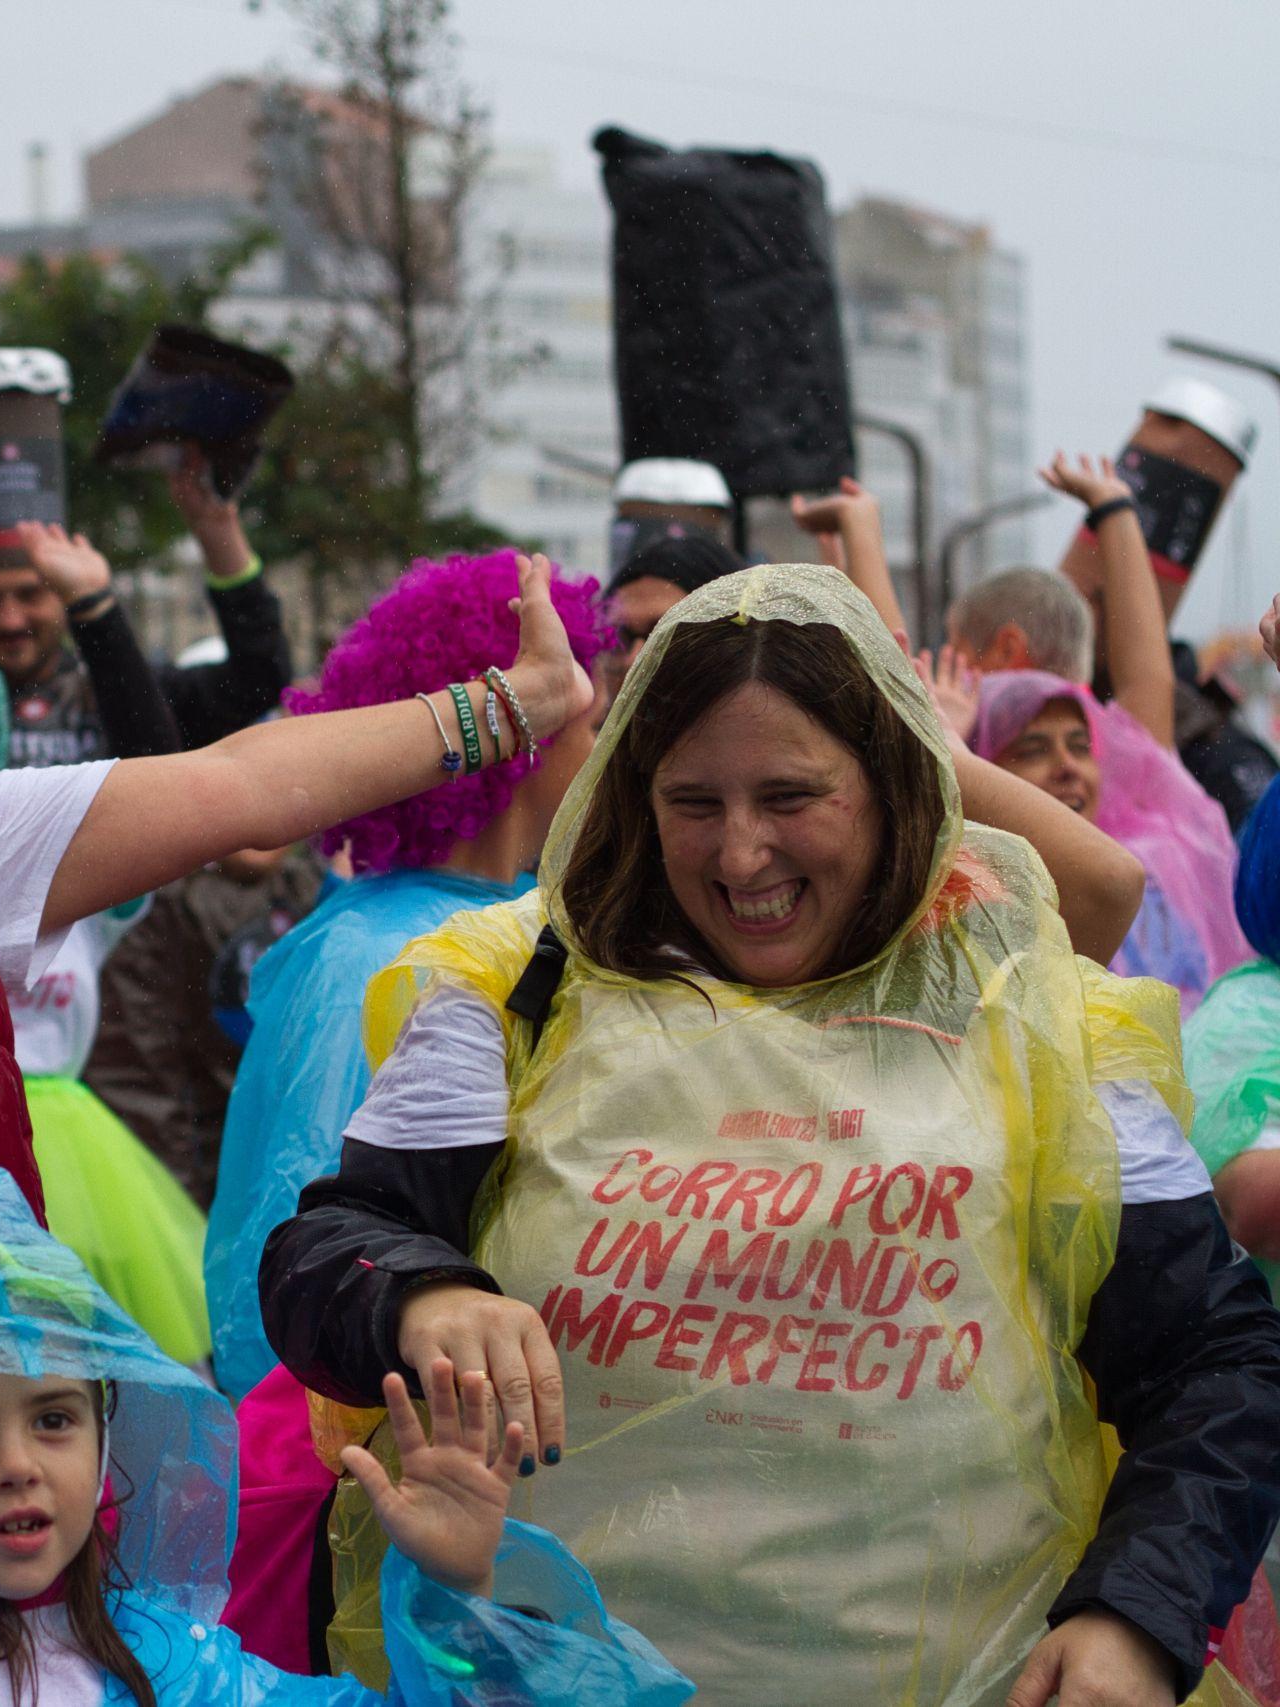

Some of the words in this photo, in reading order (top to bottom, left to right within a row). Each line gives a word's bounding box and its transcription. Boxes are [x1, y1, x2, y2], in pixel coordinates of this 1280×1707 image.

[841, 1108, 866, 1139] OCT
[591, 1148, 822, 1232] CORRO
[828, 1162, 974, 1240] POR
[573, 1218, 689, 1290] UN
[684, 1231, 960, 1317] MUNDO
[538, 1284, 983, 1400] IMPERFECTO
